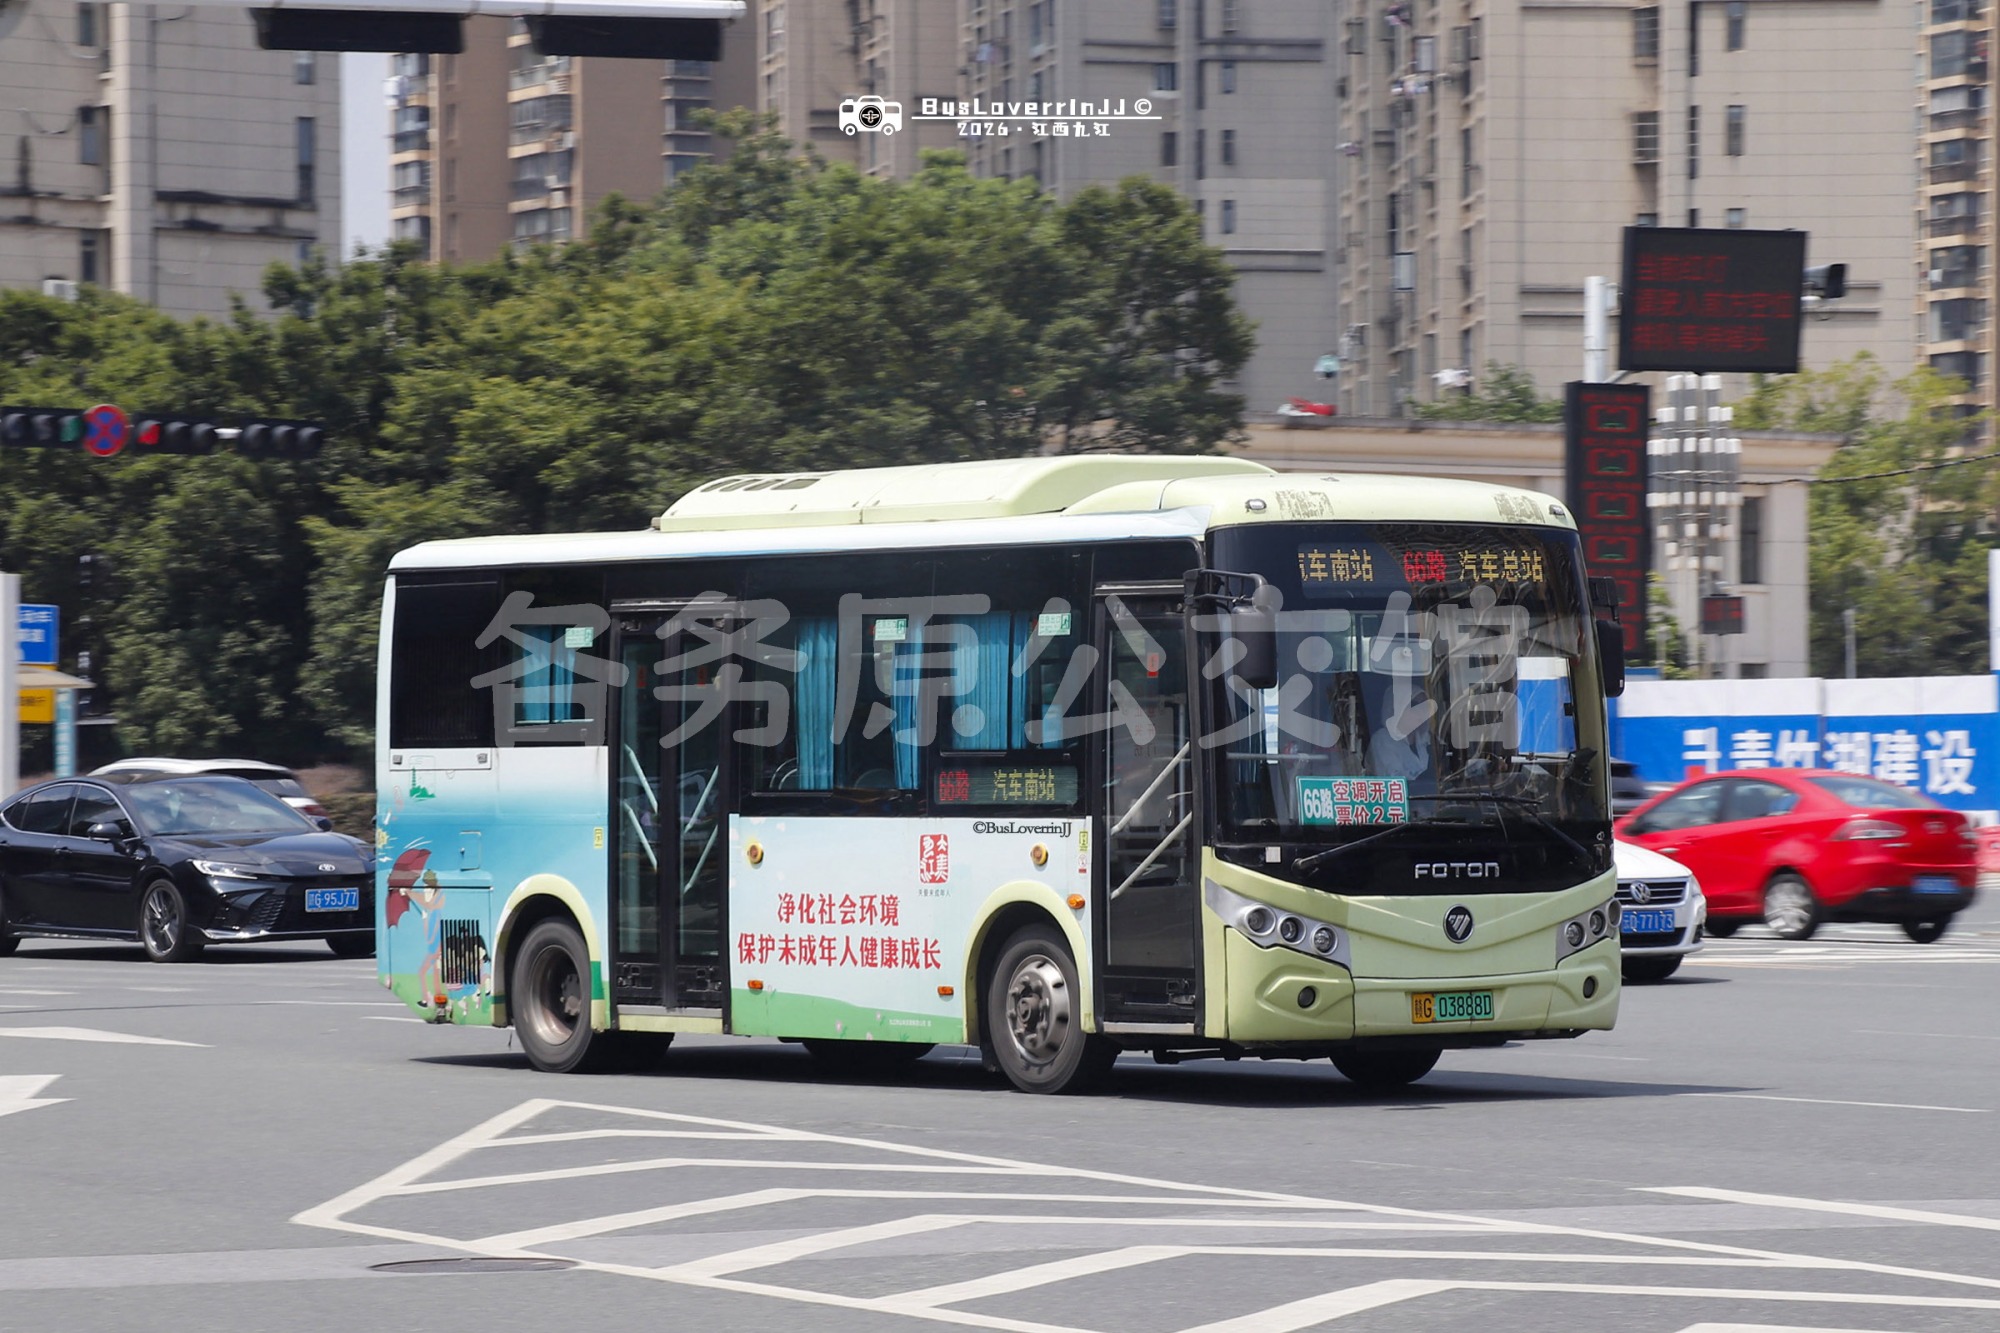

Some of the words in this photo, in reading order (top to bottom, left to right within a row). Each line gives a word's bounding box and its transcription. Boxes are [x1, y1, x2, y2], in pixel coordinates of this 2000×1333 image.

[1403, 549, 1448, 583] 66路
[1459, 549, 1544, 583] 汽车总站
[938, 769, 970, 802] 66路
[993, 768, 1056, 801] 汽车南站
[1332, 780, 1406, 804] 空调开启
[1303, 788, 1334, 819] 66路
[1415, 862, 1500, 879] FOTON
[777, 892, 900, 927] 净化社会环境
[737, 932, 942, 970] 保护未成年人健康成长
